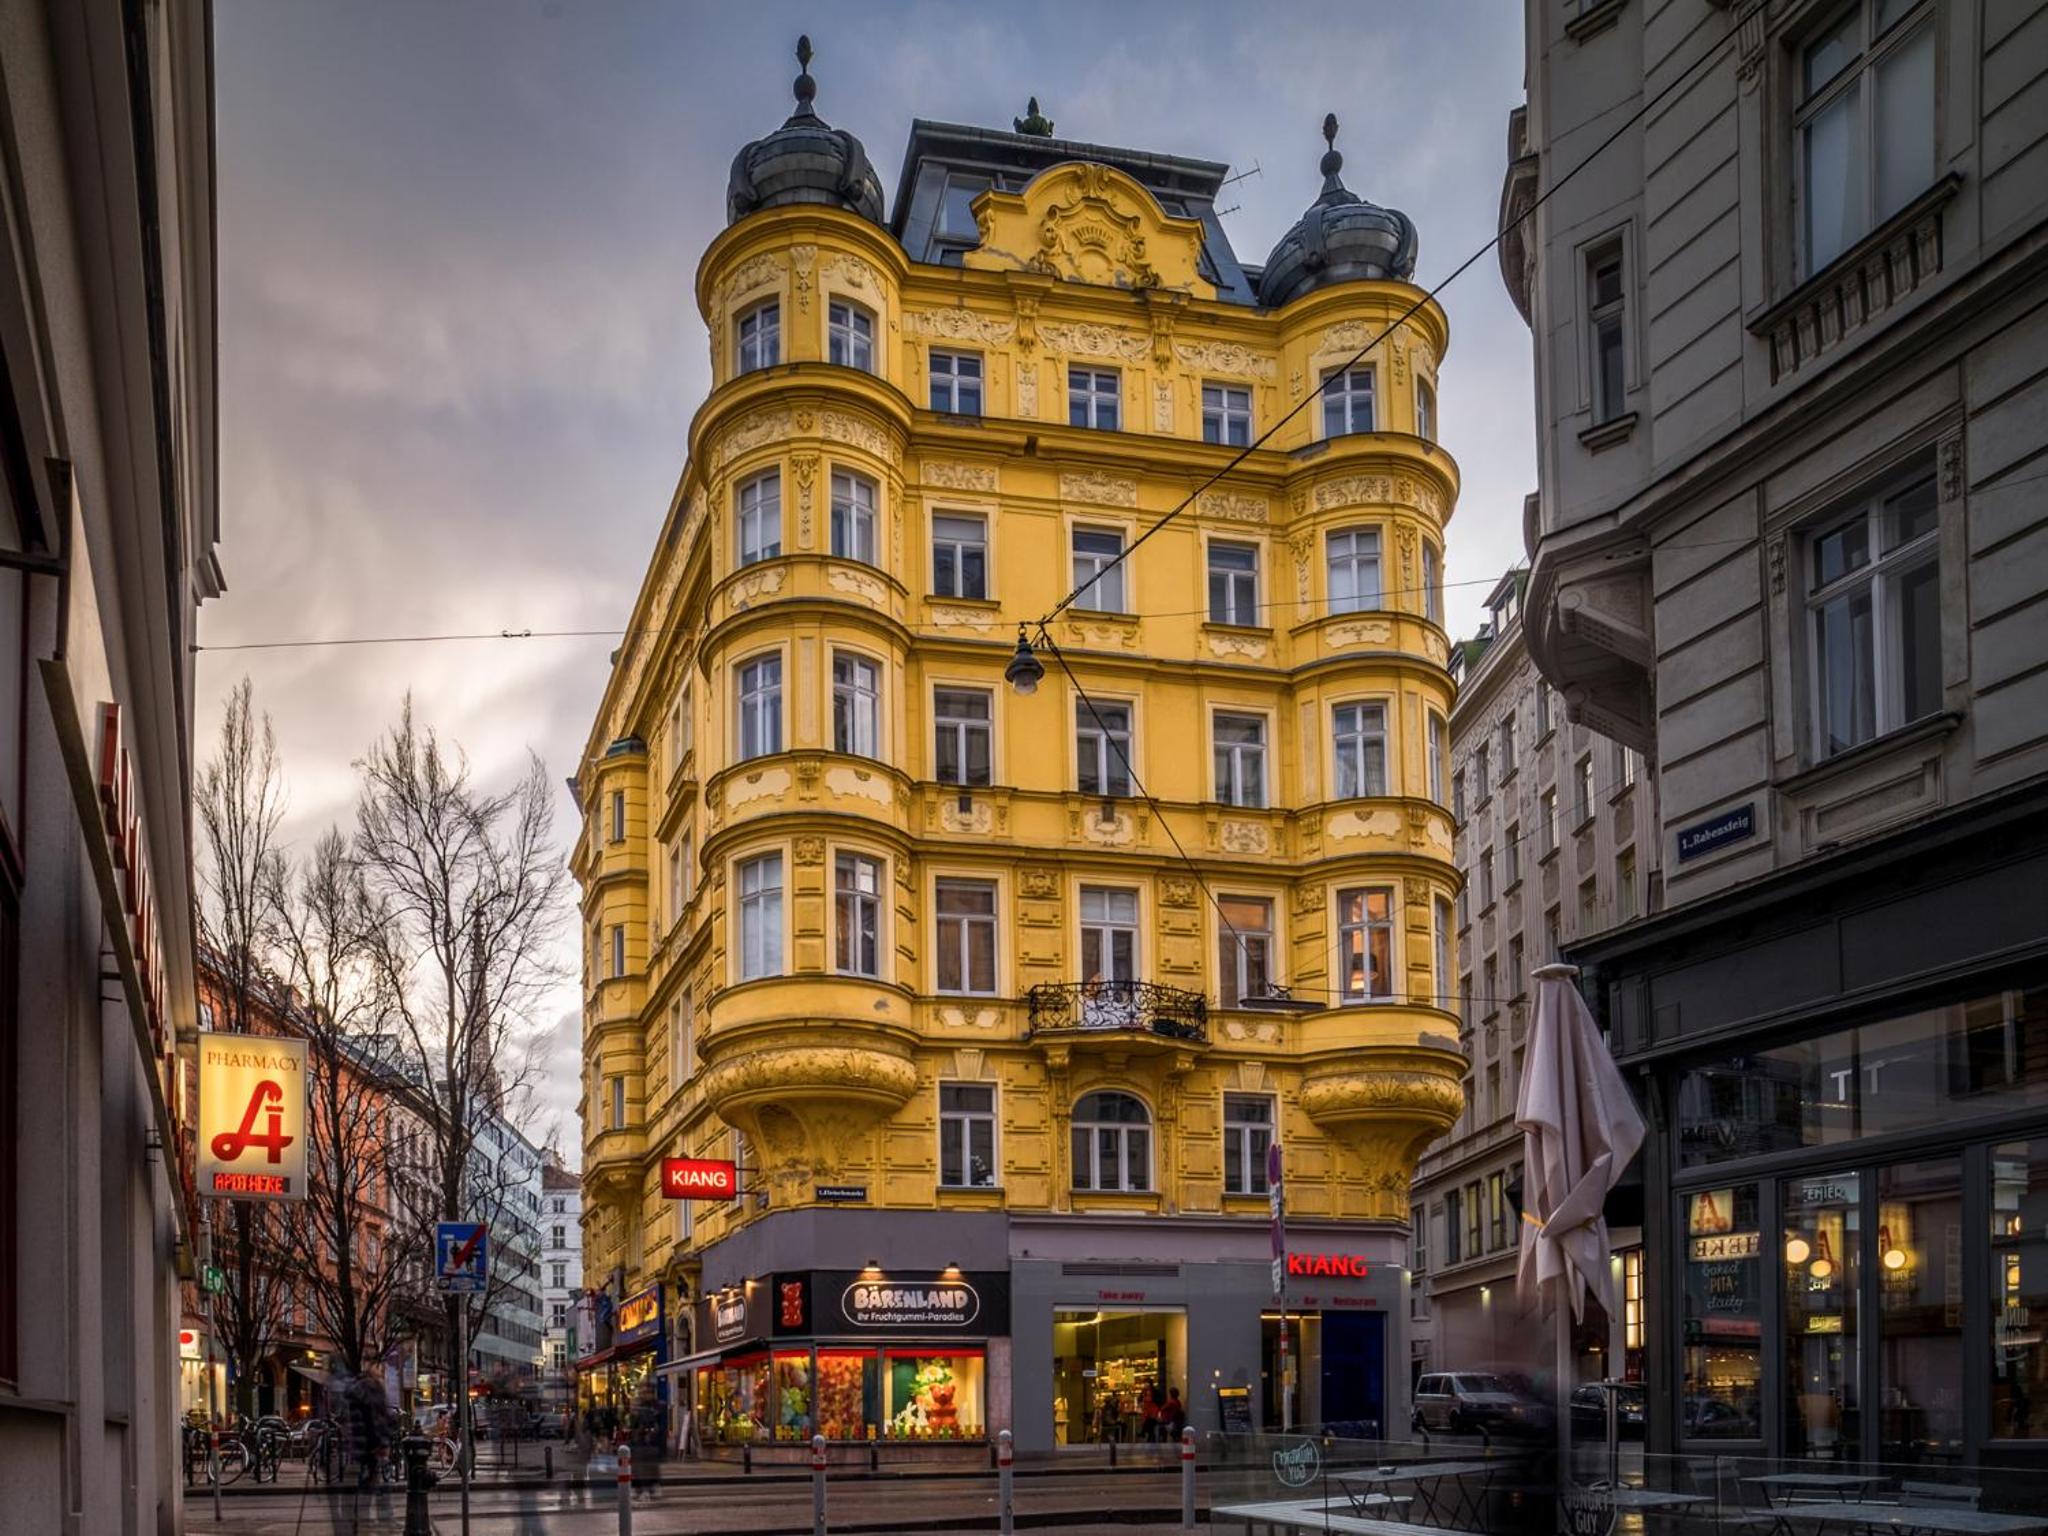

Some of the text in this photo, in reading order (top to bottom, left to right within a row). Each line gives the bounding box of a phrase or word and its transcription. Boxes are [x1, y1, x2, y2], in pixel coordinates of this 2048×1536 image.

[207, 1051, 300, 1071] PHARMACY
[215, 1174, 284, 1195] APOTHEKE
[672, 1170, 727, 1187] KIANG
[1288, 1252, 1367, 1276] KIANG
[1711, 1276, 1734, 1292] PITA
[854, 1286, 968, 1309] BÄRENLAND
[1098, 1290, 1145, 1302] Take away
[1304, 1296, 1317, 1305] Bar
[1707, 1295, 1743, 1312] daily
[857, 1312, 965, 1323] Ihr Fruchtgummi-Paradies
[1576, 1510, 1597, 1534] GUY
